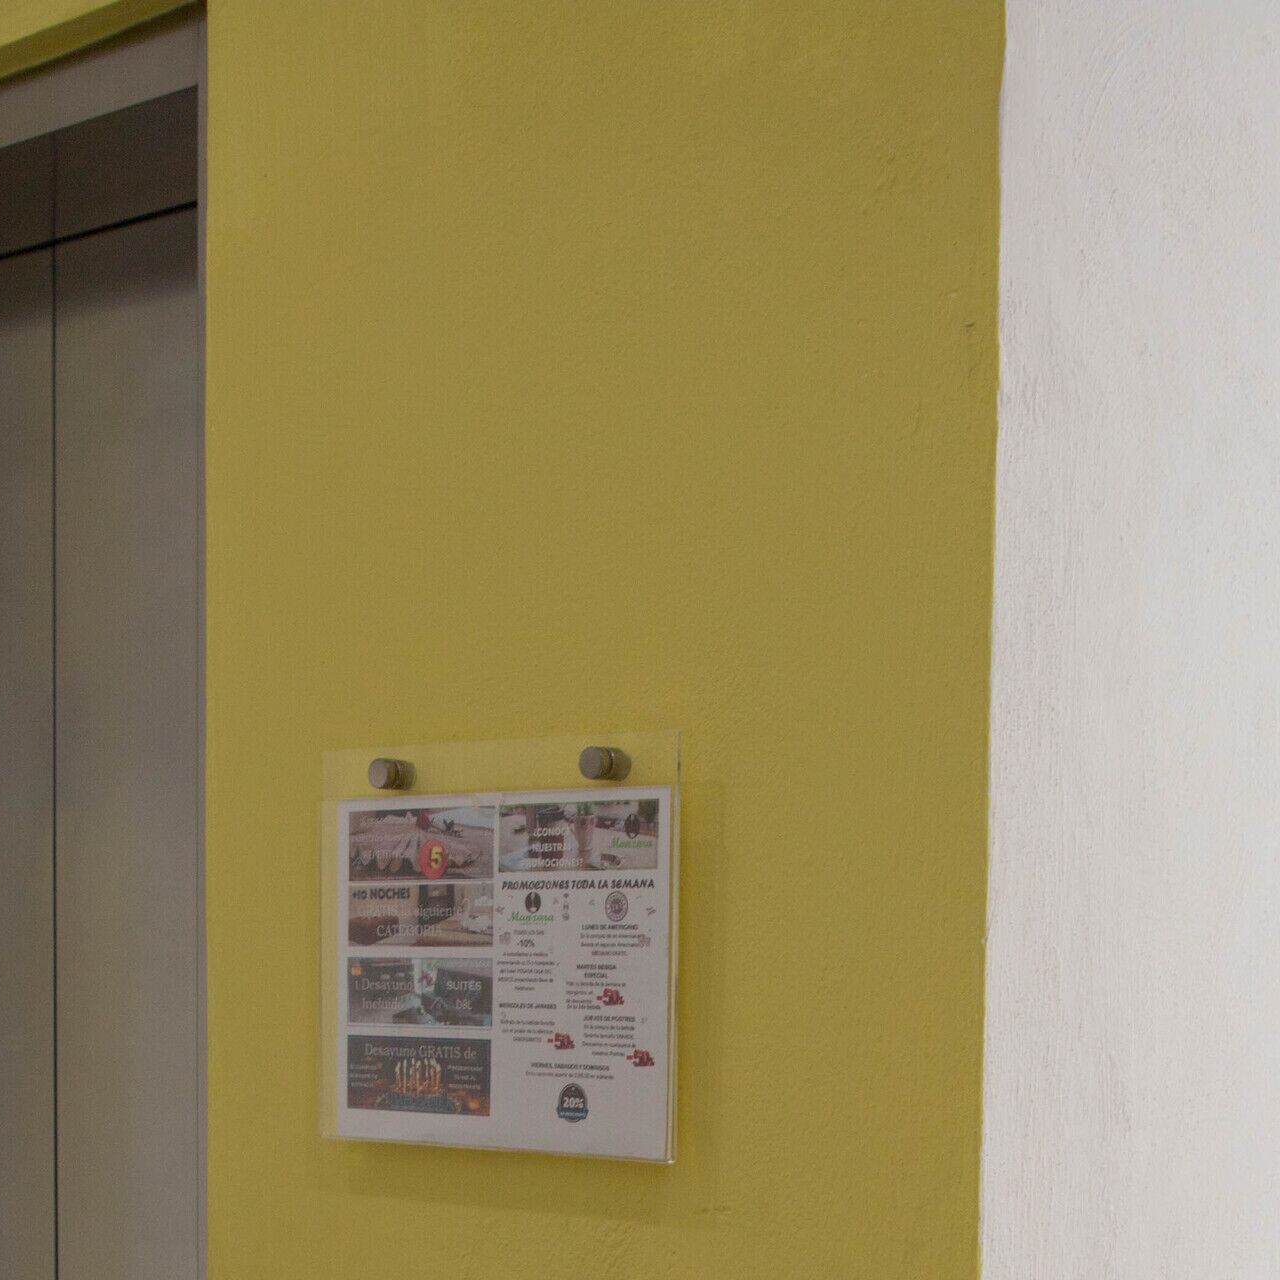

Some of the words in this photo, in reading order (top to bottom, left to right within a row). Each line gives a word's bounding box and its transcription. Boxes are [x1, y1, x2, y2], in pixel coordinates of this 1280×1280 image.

[430, 845, 443, 869] 5
[501, 879, 569, 890] PROMOCIONES
[572, 879, 595, 889] TODA
[598, 879, 608, 889] LA
[611, 878, 655, 889] SEMANA
[370, 887, 411, 900] NOCHES
[362, 977, 416, 994] Desayuno
[446, 980, 482, 992] SUITES
[364, 1043, 417, 1060] Desayuno
[419, 1045, 462, 1059] GRATIS
[464, 1047, 477, 1060] de
[563, 1097, 585, 1109] 20%
